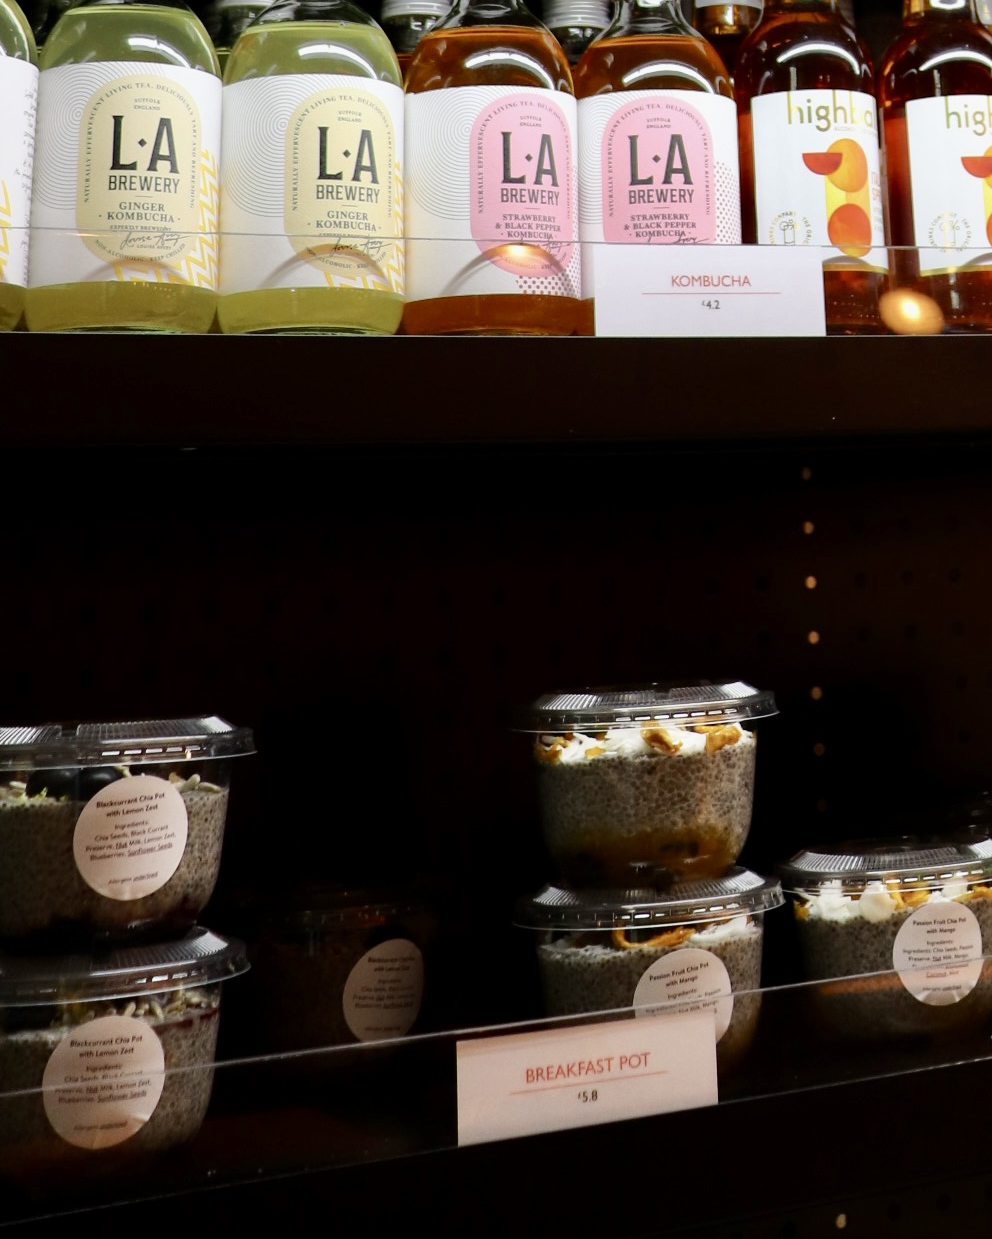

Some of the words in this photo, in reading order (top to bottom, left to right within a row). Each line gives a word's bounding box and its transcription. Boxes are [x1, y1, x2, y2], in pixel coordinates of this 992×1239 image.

[105, 83, 133, 98] LIVING
[310, 95, 337, 110] LIVING
[493, 102, 518, 115] LIVING
[621, 105, 645, 120] LIVING
[108, 174, 181, 194] BREWERY
[315, 184, 381, 204] BREWERY
[501, 187, 560, 206] BREWERY
[628, 189, 695, 205] BREWERY
[119, 201, 165, 212] GINGER
[107, 211, 175, 223] KOMBUCHA
[327, 210, 369, 221] GINGER
[502, 214, 556, 223] STRAWBERRY
[630, 213, 691, 222] STRAWBERRY
[315, 220, 377, 232] KOMBUCHA
[495, 222, 502, 230] &
[505, 222, 533, 230] BLACK
[535, 223, 561, 233] PEPPER
[665, 222, 697, 230] PEPPER
[507, 231, 554, 240] KOMBUCHA
[636, 230, 688, 238] KOMBUCHA
[671, 275, 751, 287] KOMBUCHA
[96, 797, 138, 808] Blackcurrant
[649, 973, 670, 981] Passion
[679, 975, 698, 983] Mango
[70, 1039, 113, 1048] Blackcurrant
[115, 1037, 130, 1045] Chia
[95, 1049, 118, 1057] Lemon
[120, 1047, 134, 1055] Zest
[525, 1058, 614, 1083] BREAKFAST
[619, 1052, 651, 1070] POT
